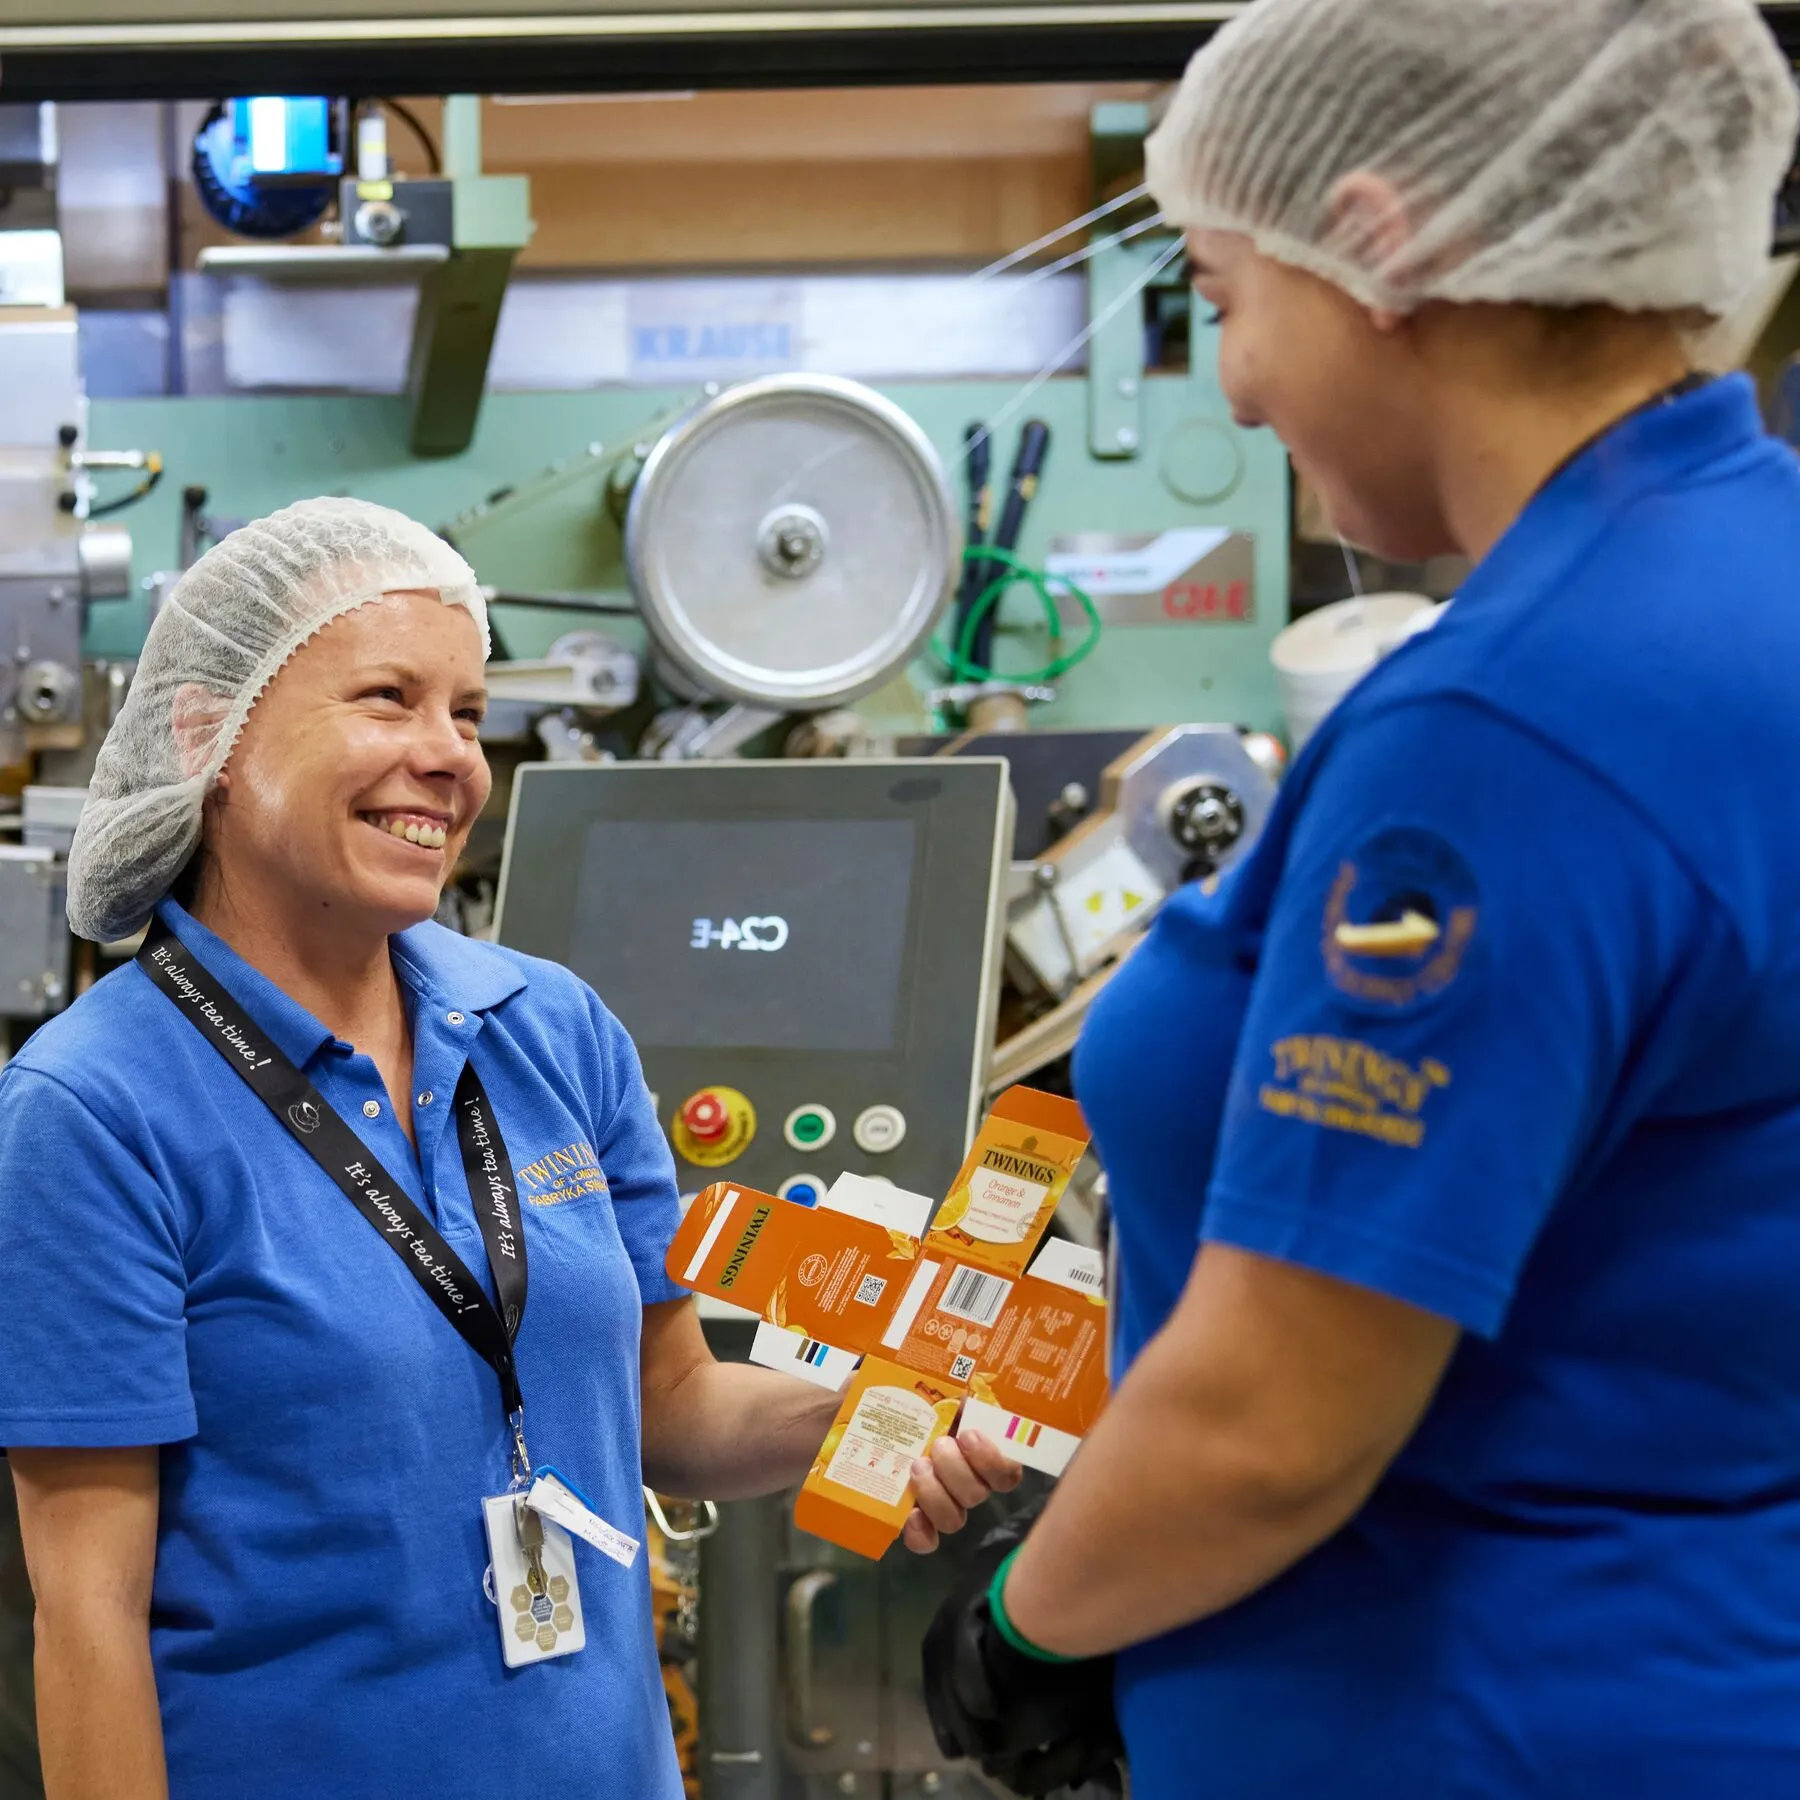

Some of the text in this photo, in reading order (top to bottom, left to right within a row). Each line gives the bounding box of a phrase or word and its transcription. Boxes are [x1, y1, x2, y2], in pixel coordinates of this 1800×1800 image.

[151, 946, 172, 966] It's
[164, 965, 205, 1003] always
[200, 1001, 224, 1027] tea
[482, 1148, 498, 1173] tea
[983, 1149, 1057, 1184] TWININGS
[527, 1184, 587, 1206] FABRYKA
[553, 1177, 566, 1189] OF
[988, 1179, 1026, 1198] Orange &
[488, 1175, 512, 1229] always
[982, 1190, 1022, 1209] Cinnamon
[344, 1161, 371, 1187] It's
[365, 1188, 415, 1239] always
[409, 1239, 433, 1267] tea
[498, 1231, 516, 1259] It's
[720, 1207, 770, 1288] TWININGS
